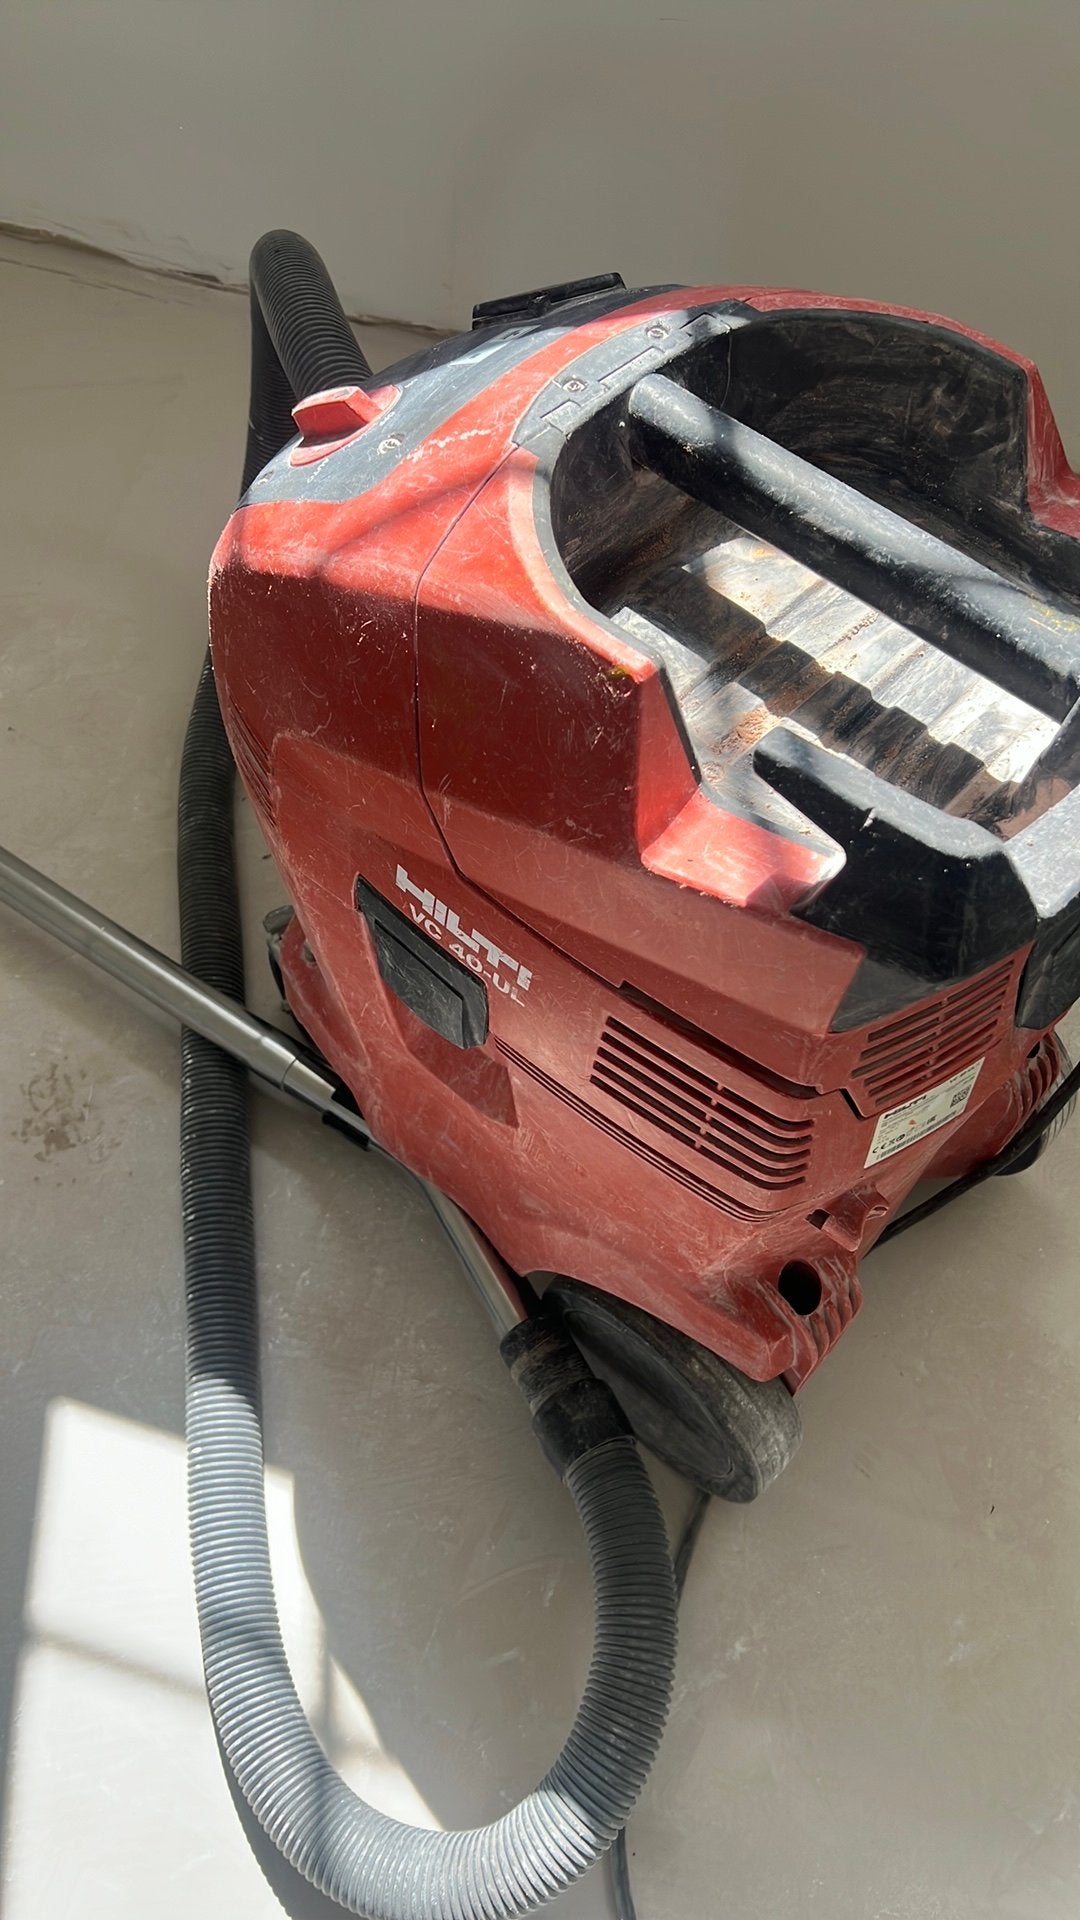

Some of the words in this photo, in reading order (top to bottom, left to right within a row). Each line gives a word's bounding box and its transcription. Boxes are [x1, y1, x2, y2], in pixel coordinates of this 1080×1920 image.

[395, 863, 533, 991] HILTI
[408, 902, 443, 940] VC
[448, 943, 526, 1008] 40-UL
